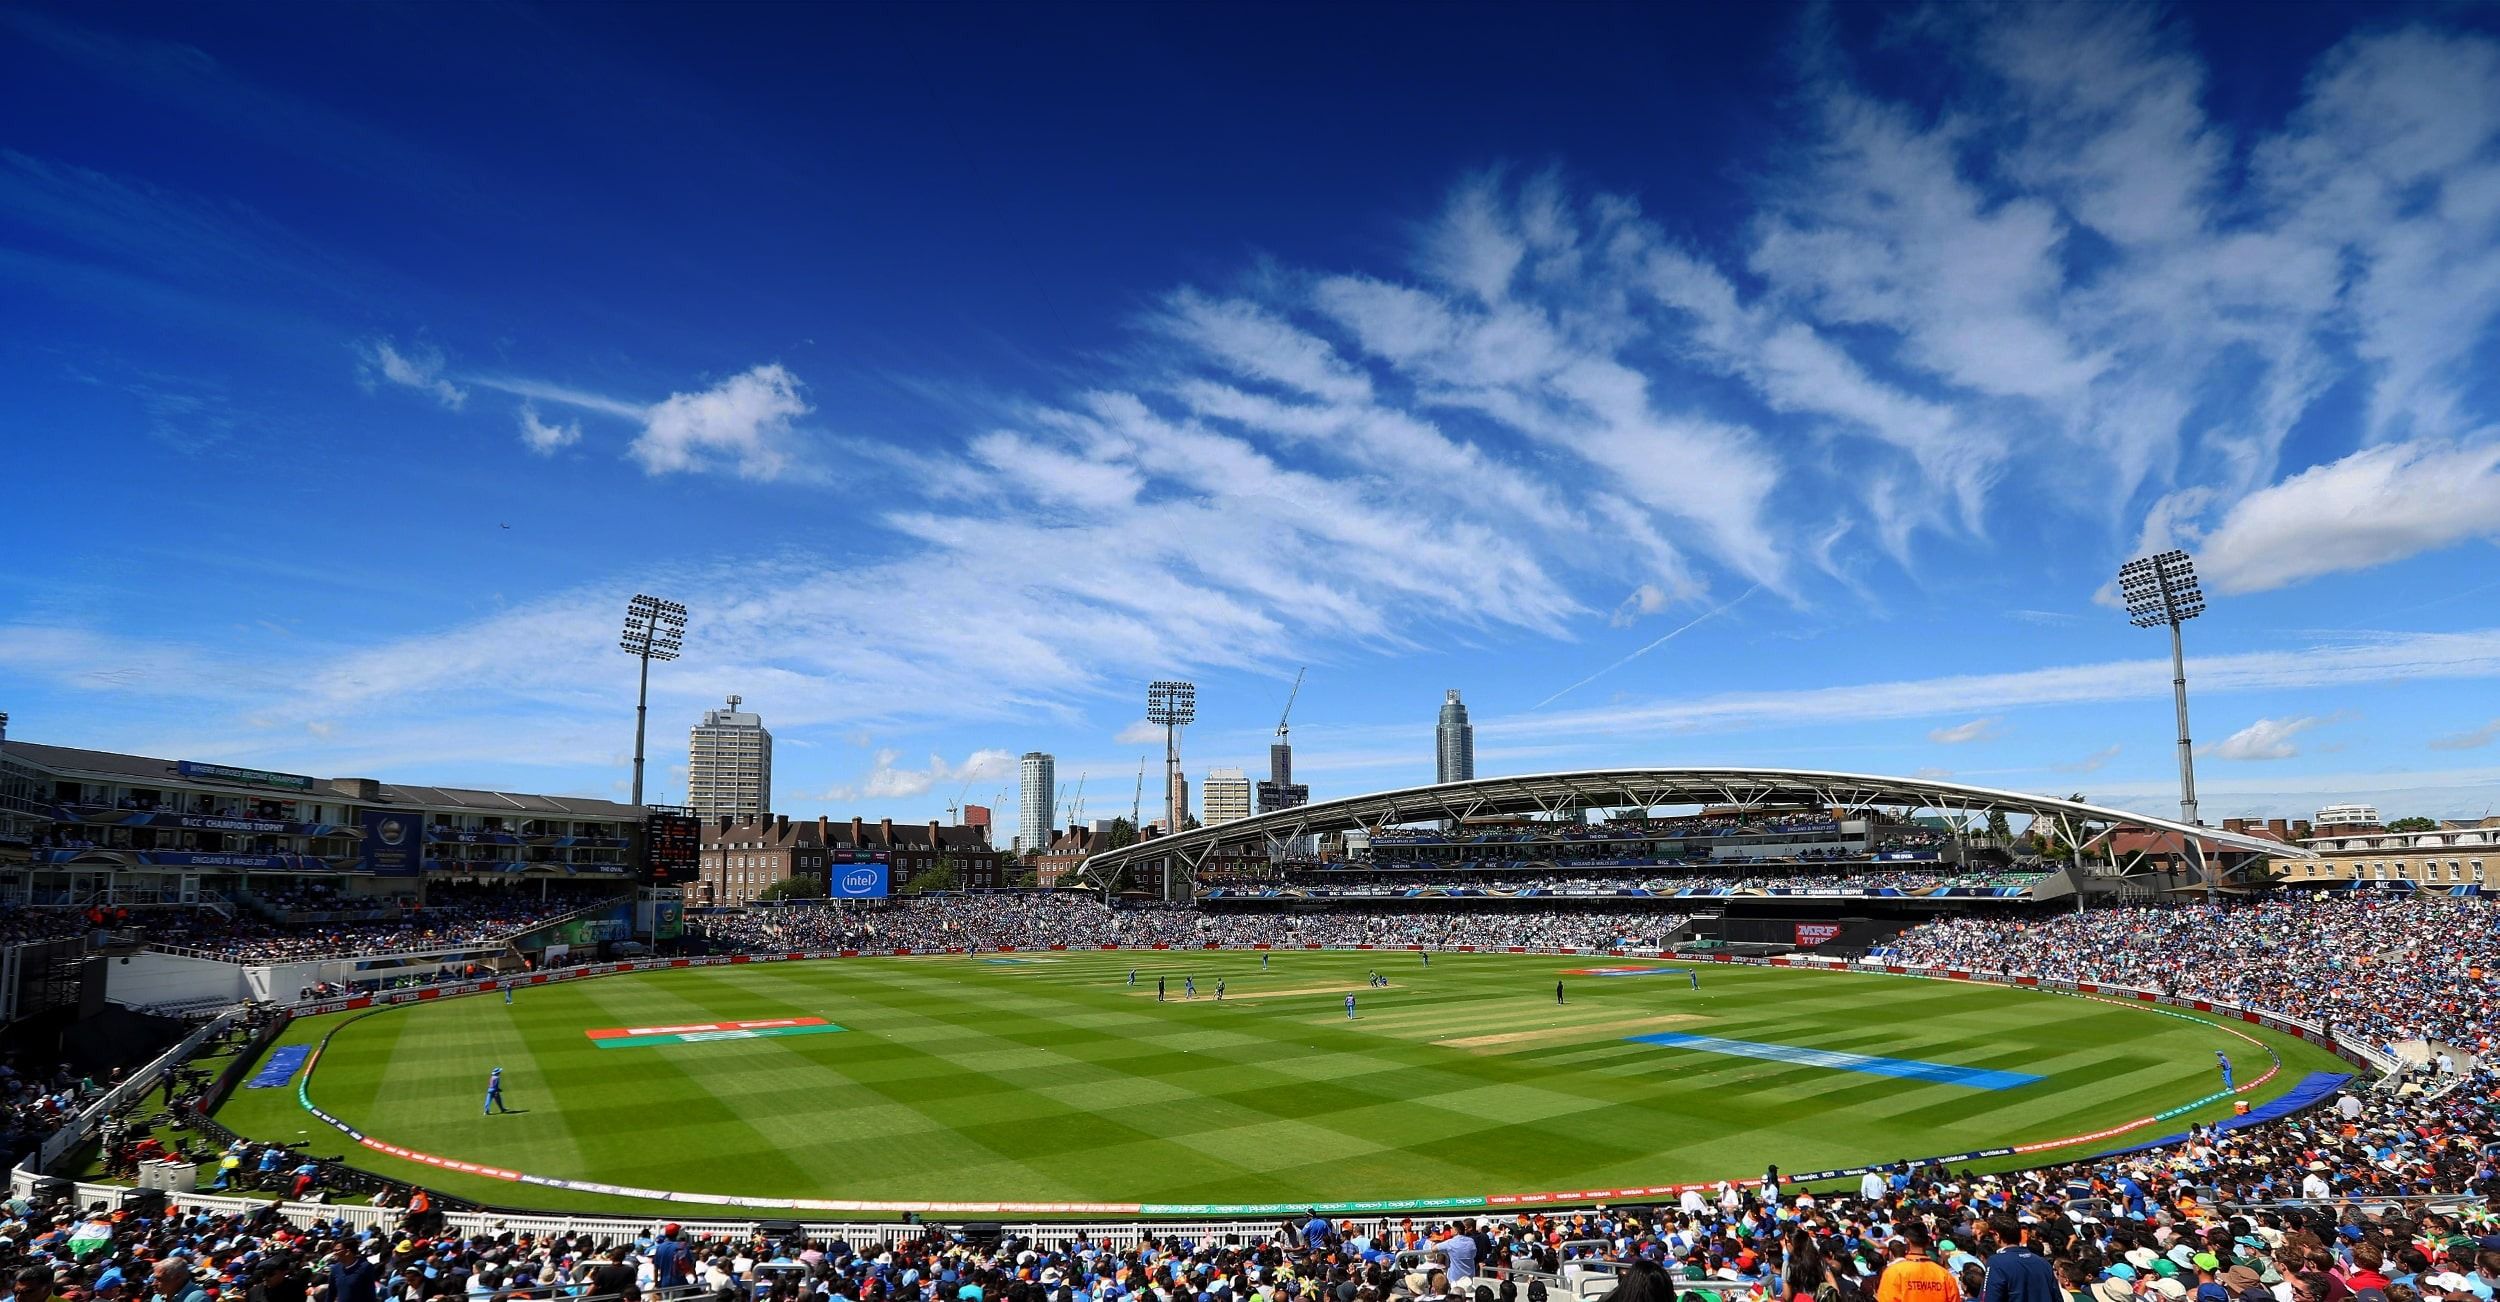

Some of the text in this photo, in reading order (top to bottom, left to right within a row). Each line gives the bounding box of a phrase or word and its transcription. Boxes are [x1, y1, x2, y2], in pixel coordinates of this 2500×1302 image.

[190, 765, 304, 785] WHERE HEROES BECOME CHAMPIONS
[190, 819, 284, 832] ICC CHAMPIONS TROPHY
[192, 856, 225, 865] ENGLAND
[233, 857, 253, 866] WALES
[847, 874, 871, 886] intel
[2381, 881, 2390, 889] ICC
[1798, 926, 1838, 936] MRF
[1926, 969, 1950, 977] TYRES
[1992, 974, 2016, 983] TYRES
[2036, 979, 2079, 990] MRF TYRES
[2098, 987, 2139, 998] MRF TYRES
[2155, 995, 2195, 1008] MRF TYRES
[1907, 1280, 1942, 1292] STEWARD
